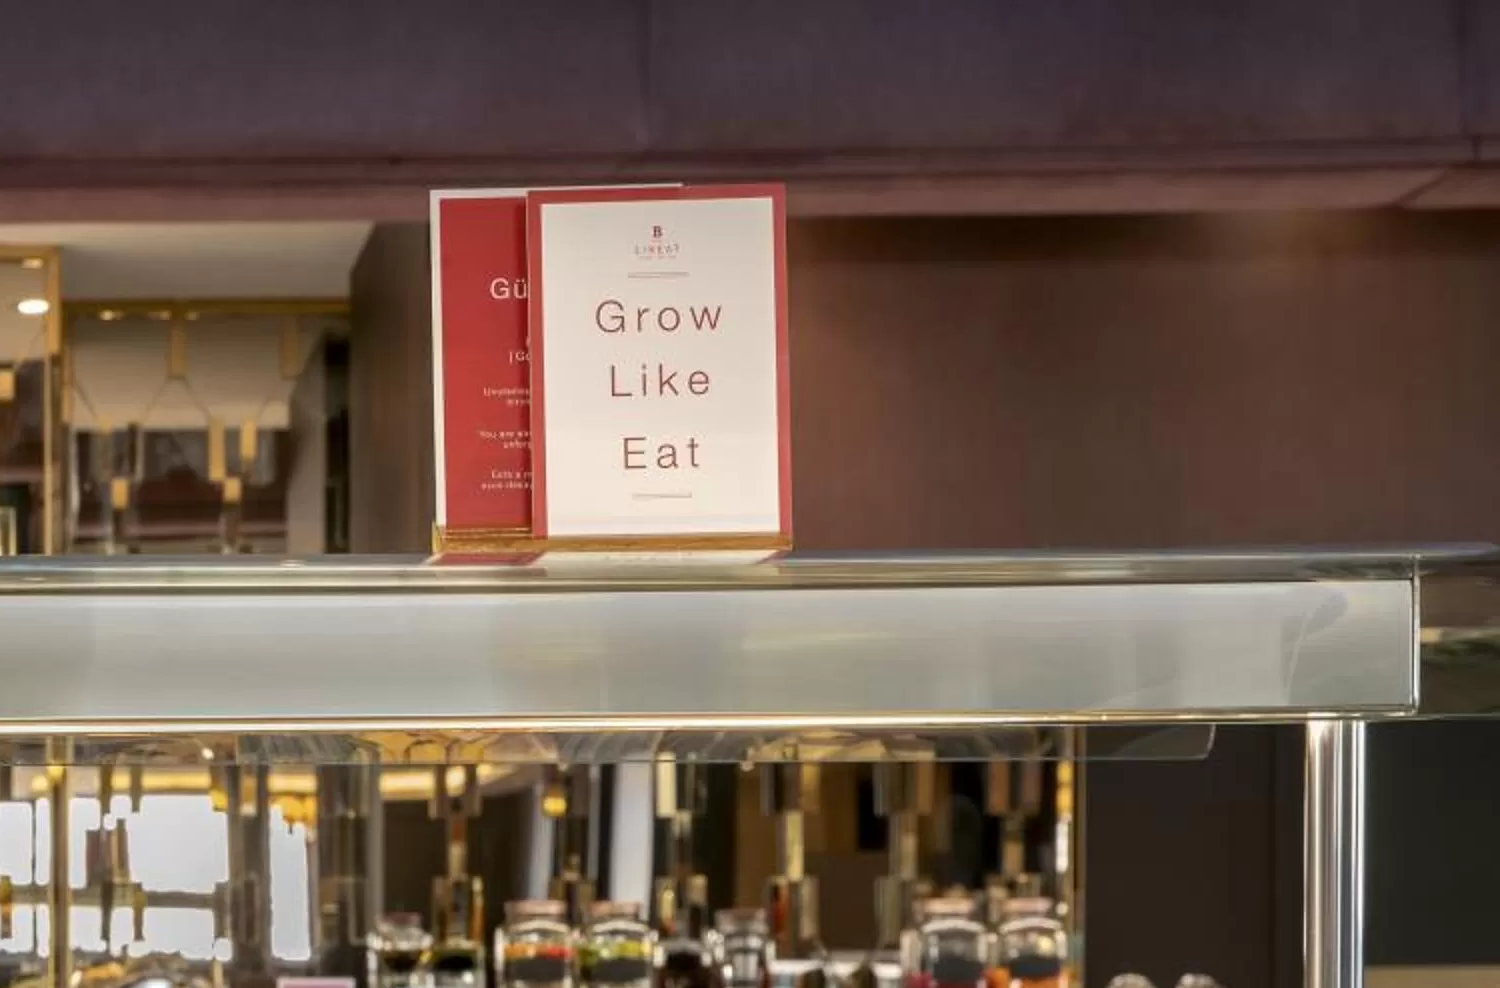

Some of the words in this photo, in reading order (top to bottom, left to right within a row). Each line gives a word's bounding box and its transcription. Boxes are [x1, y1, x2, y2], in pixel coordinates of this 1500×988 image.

[490, 277, 529, 299] Gü
[595, 299, 722, 333] Grow
[610, 363, 710, 397] Like
[622, 436, 700, 470] Eat
